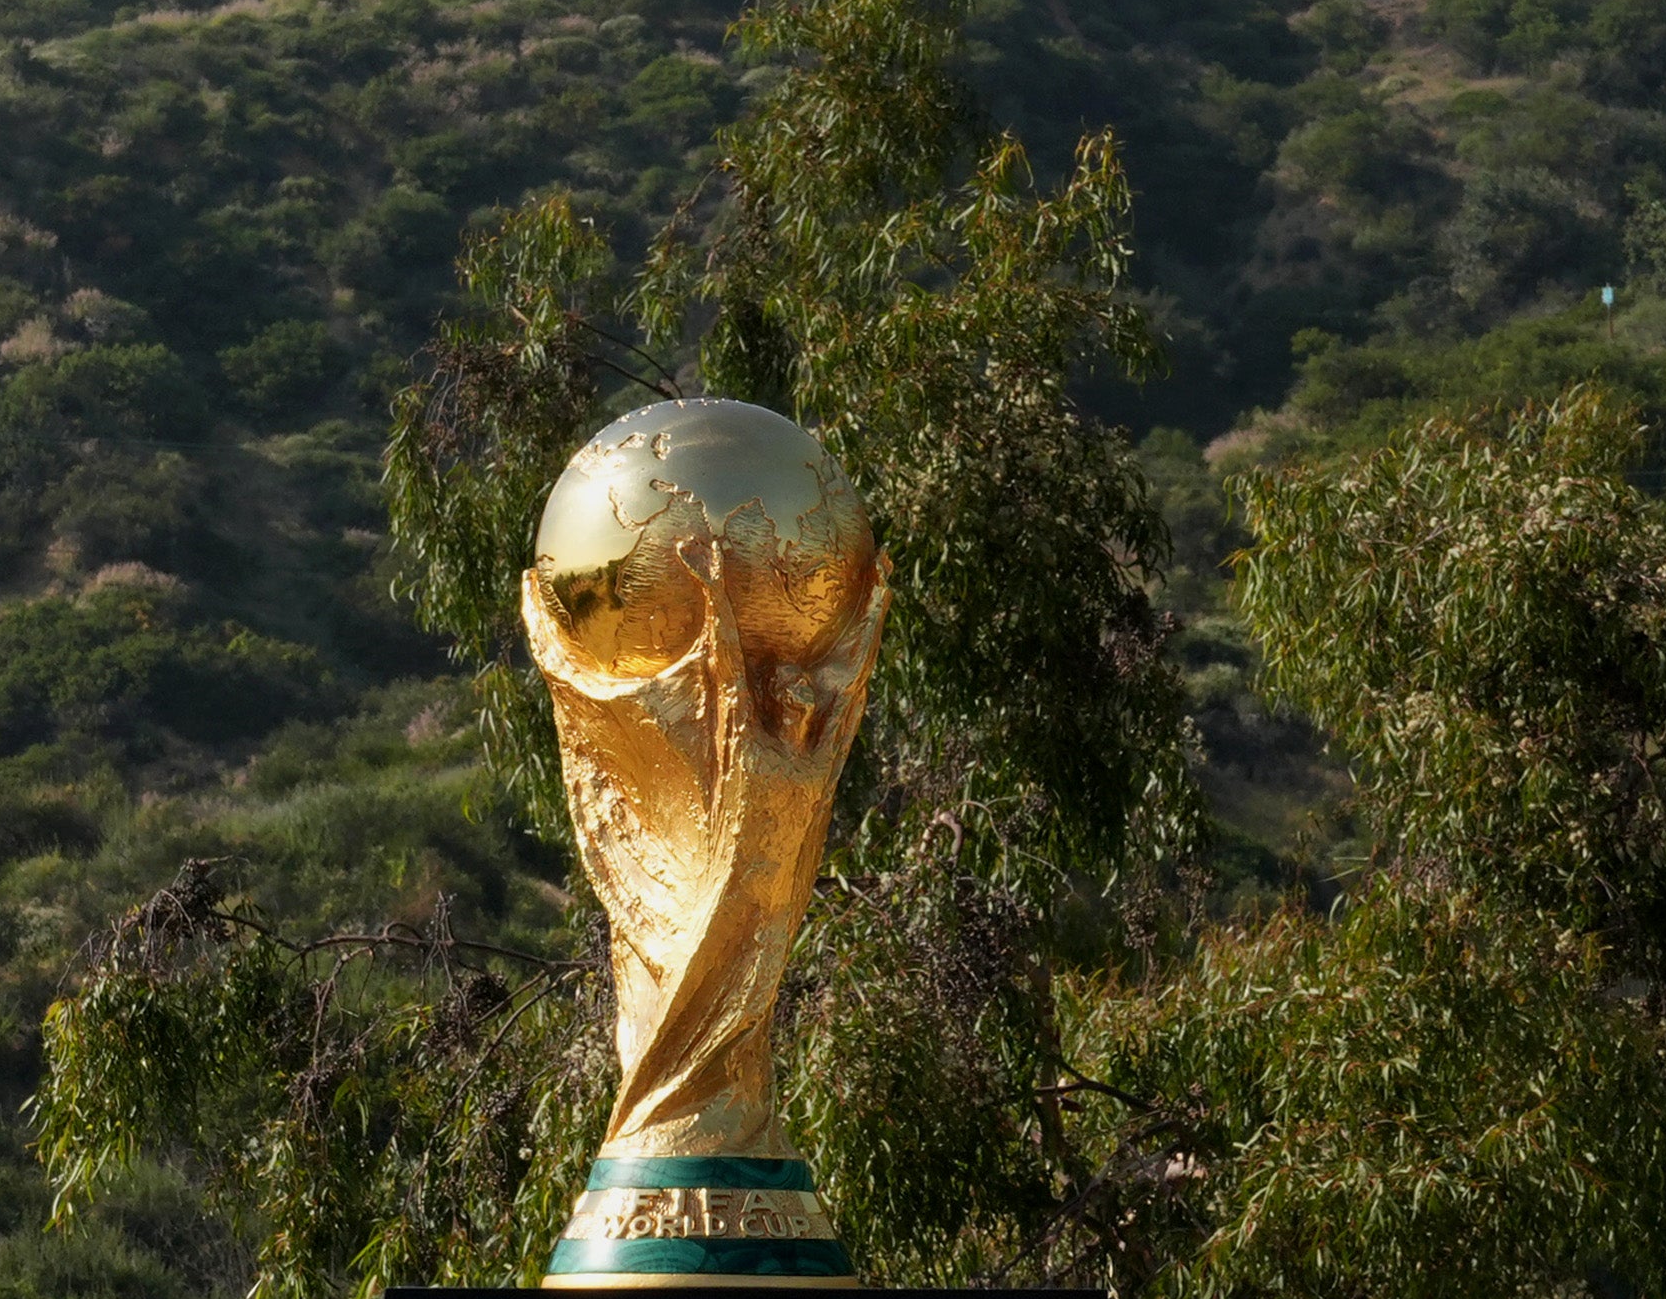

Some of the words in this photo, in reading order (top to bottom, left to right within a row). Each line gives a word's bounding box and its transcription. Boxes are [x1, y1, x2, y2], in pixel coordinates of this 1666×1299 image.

[628, 1188, 777, 1214] FIFA
[604, 1213, 728, 1238] WORLD
[739, 1213, 811, 1238] CUP
